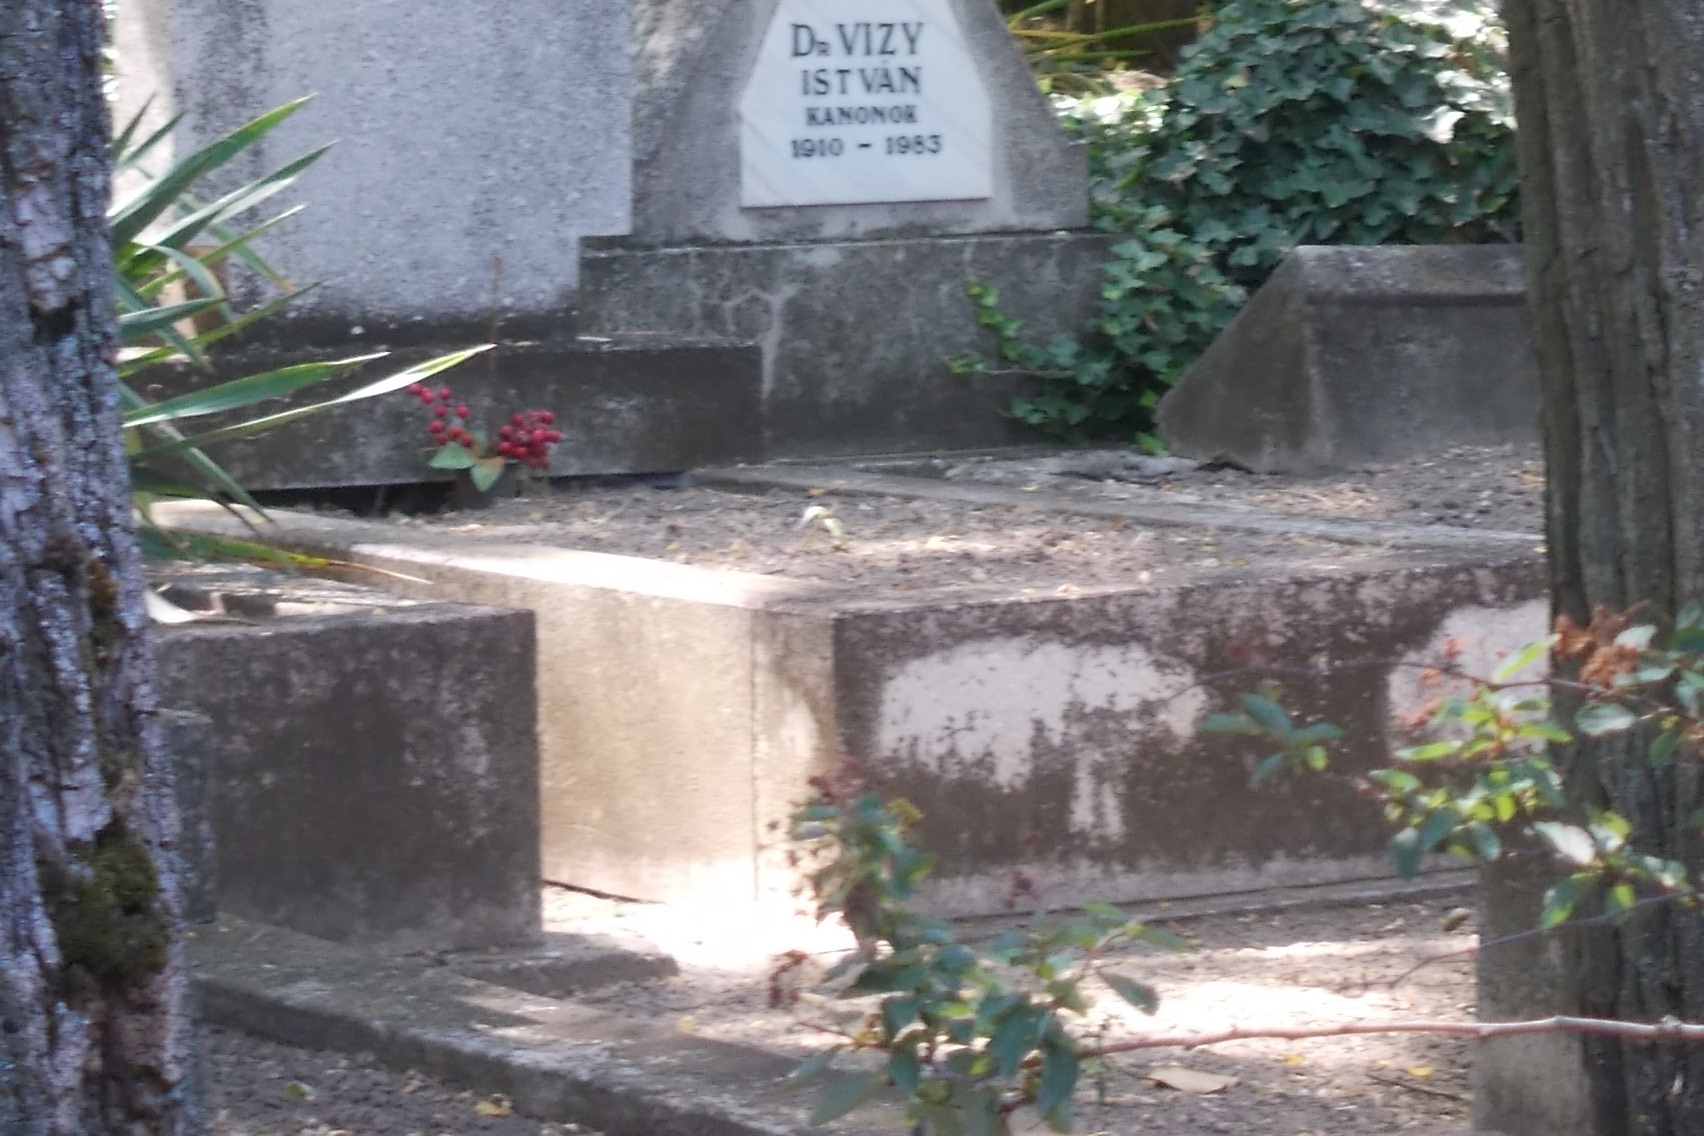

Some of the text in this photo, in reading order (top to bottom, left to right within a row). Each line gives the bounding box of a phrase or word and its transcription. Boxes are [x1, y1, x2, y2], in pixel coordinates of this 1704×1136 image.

[836, 22, 923, 55] VIZY
[806, 105, 918, 126] KANONOK
[791, 138, 844, 158] 1910
